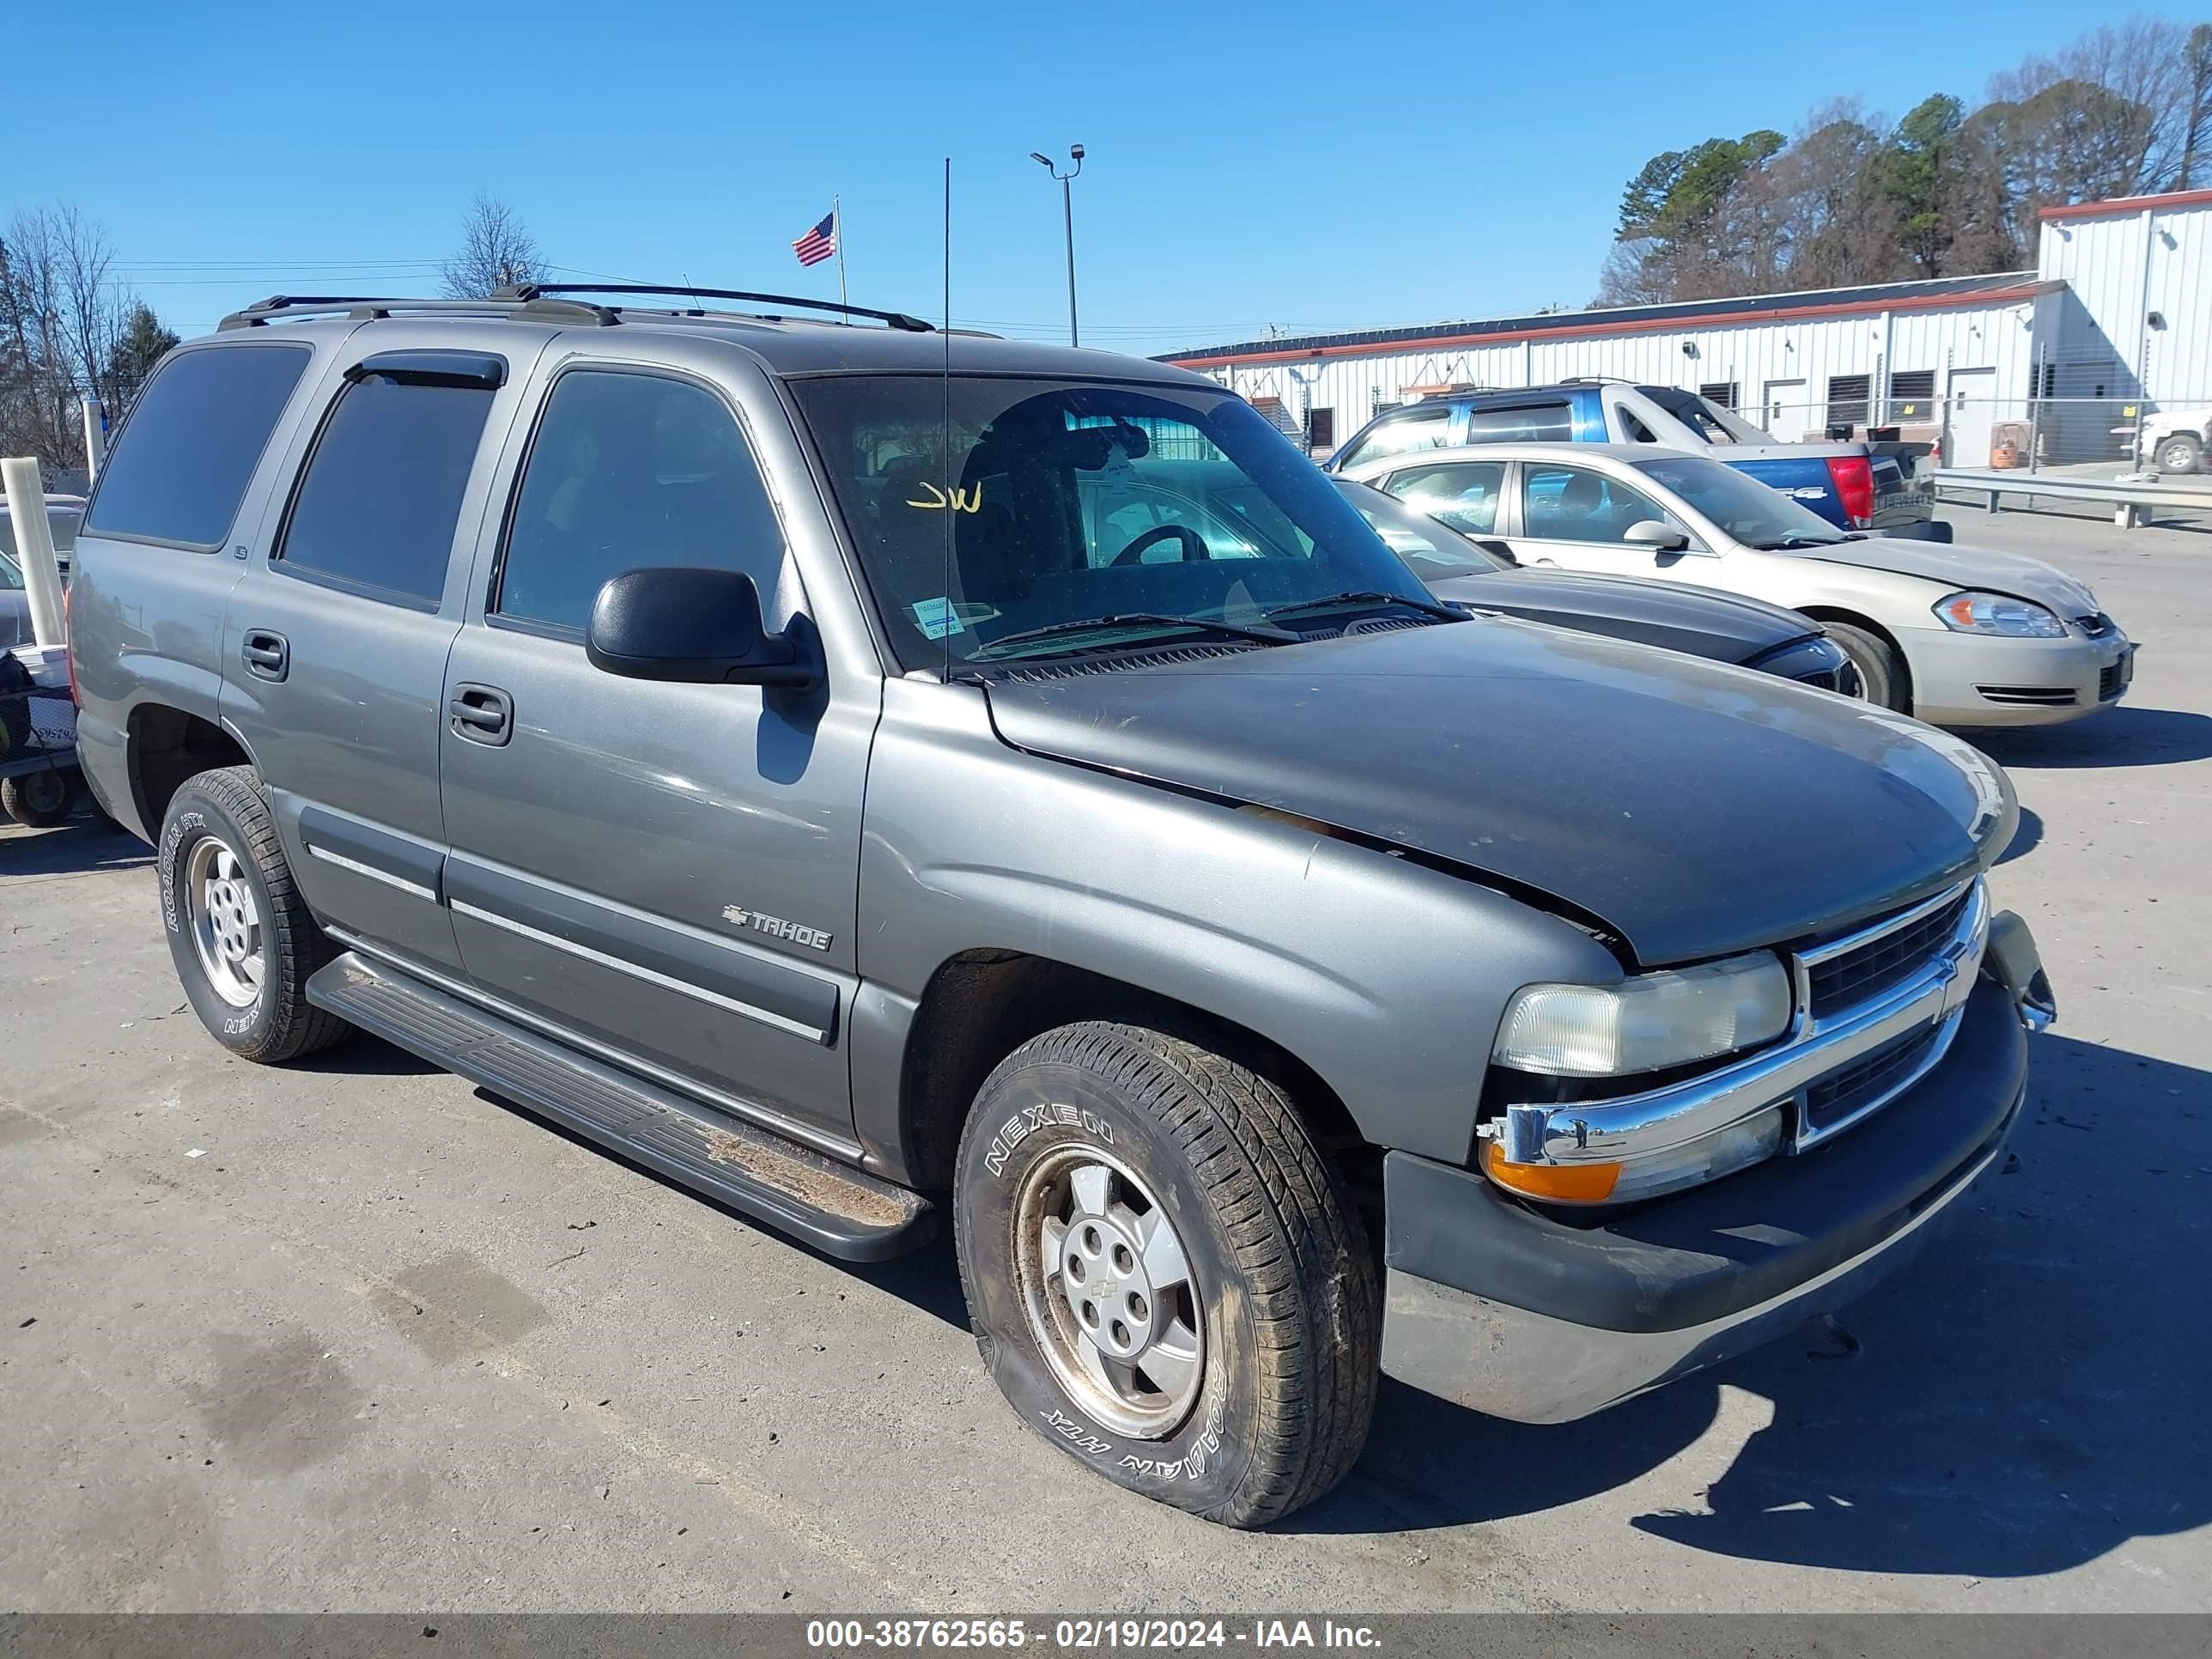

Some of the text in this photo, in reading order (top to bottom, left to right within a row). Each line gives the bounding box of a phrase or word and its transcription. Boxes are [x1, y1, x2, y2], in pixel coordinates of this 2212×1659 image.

[162, 811, 207, 933] ROADIAN HTX
[752, 913, 830, 950] TAHOE
[224, 961, 266, 1034] NEXEN
[983, 1103, 1115, 1178] NEXEN
[1039, 1360, 1227, 1480] ROADIAN HTX
